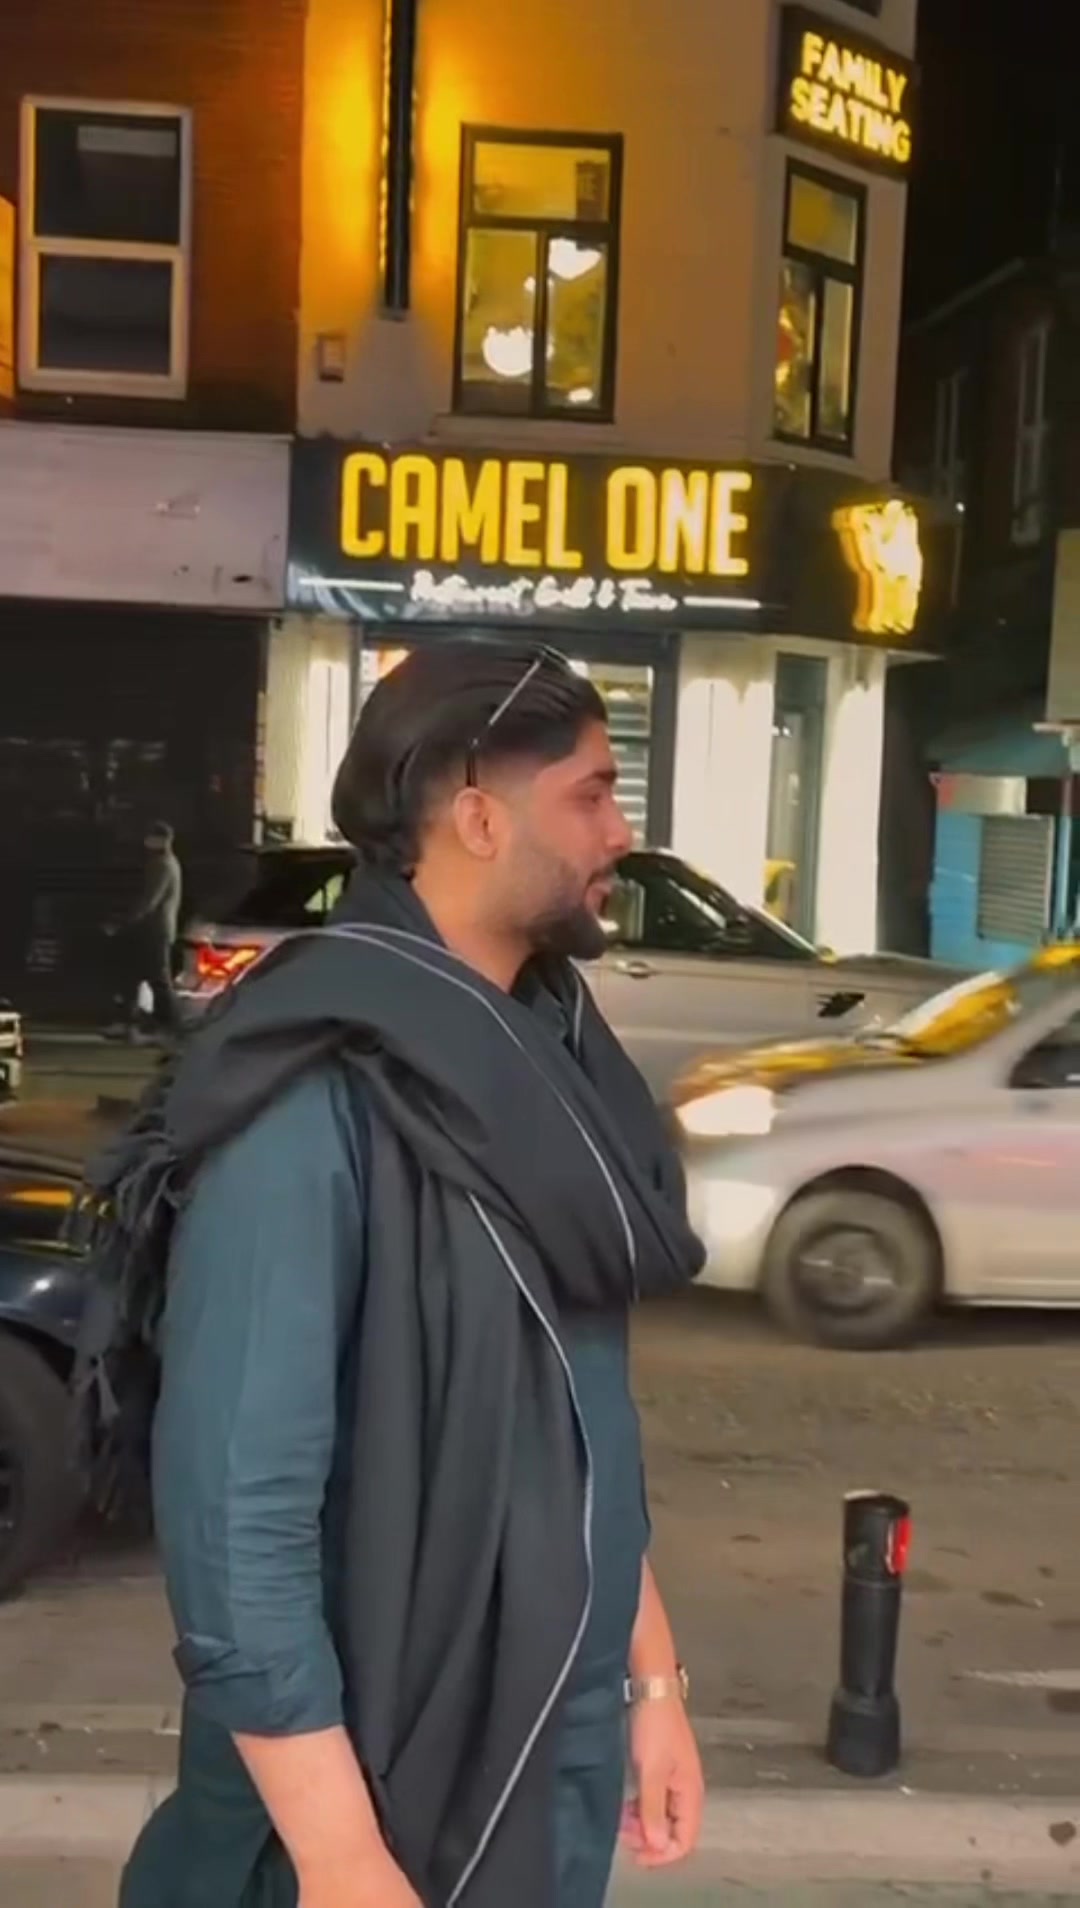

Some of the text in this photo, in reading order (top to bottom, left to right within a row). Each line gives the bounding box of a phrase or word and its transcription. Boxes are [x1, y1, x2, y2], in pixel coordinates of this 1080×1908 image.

[802, 31, 907, 113] FAMILY
[791, 77, 912, 162] SEATING
[341, 452, 752, 576] CAMEL ONE
